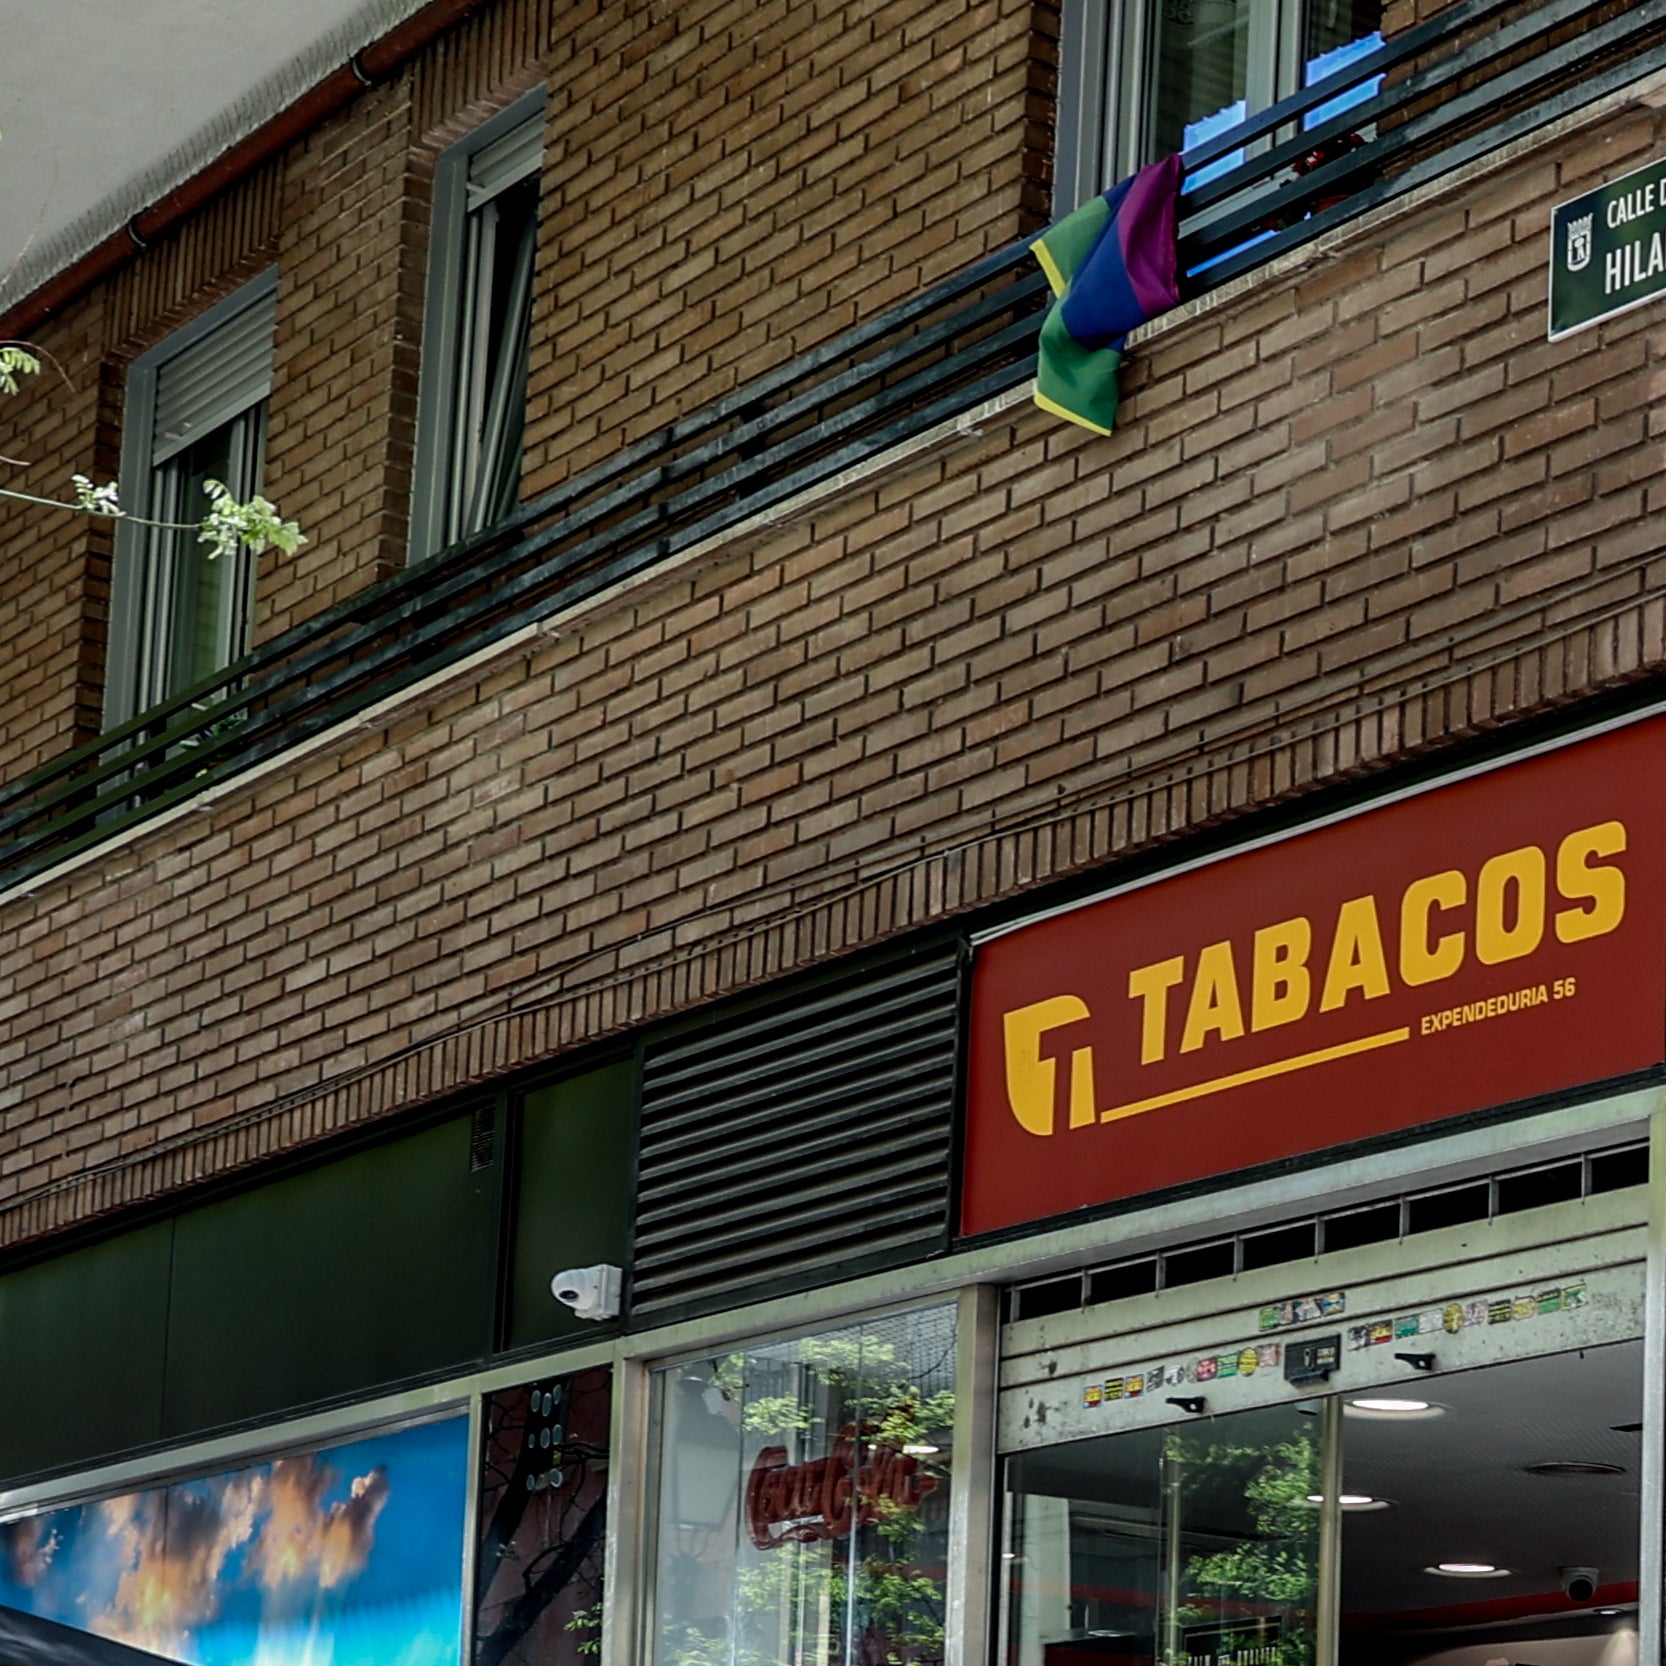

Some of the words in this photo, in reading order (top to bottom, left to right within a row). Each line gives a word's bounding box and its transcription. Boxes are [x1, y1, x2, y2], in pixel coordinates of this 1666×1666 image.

[1607, 184, 1654, 229] CALLE
[1128, 820, 1627, 1066] TABACOS
[1420, 986, 1549, 1036] EXPENDEDURIA
[1553, 978, 1576, 1001] 56
